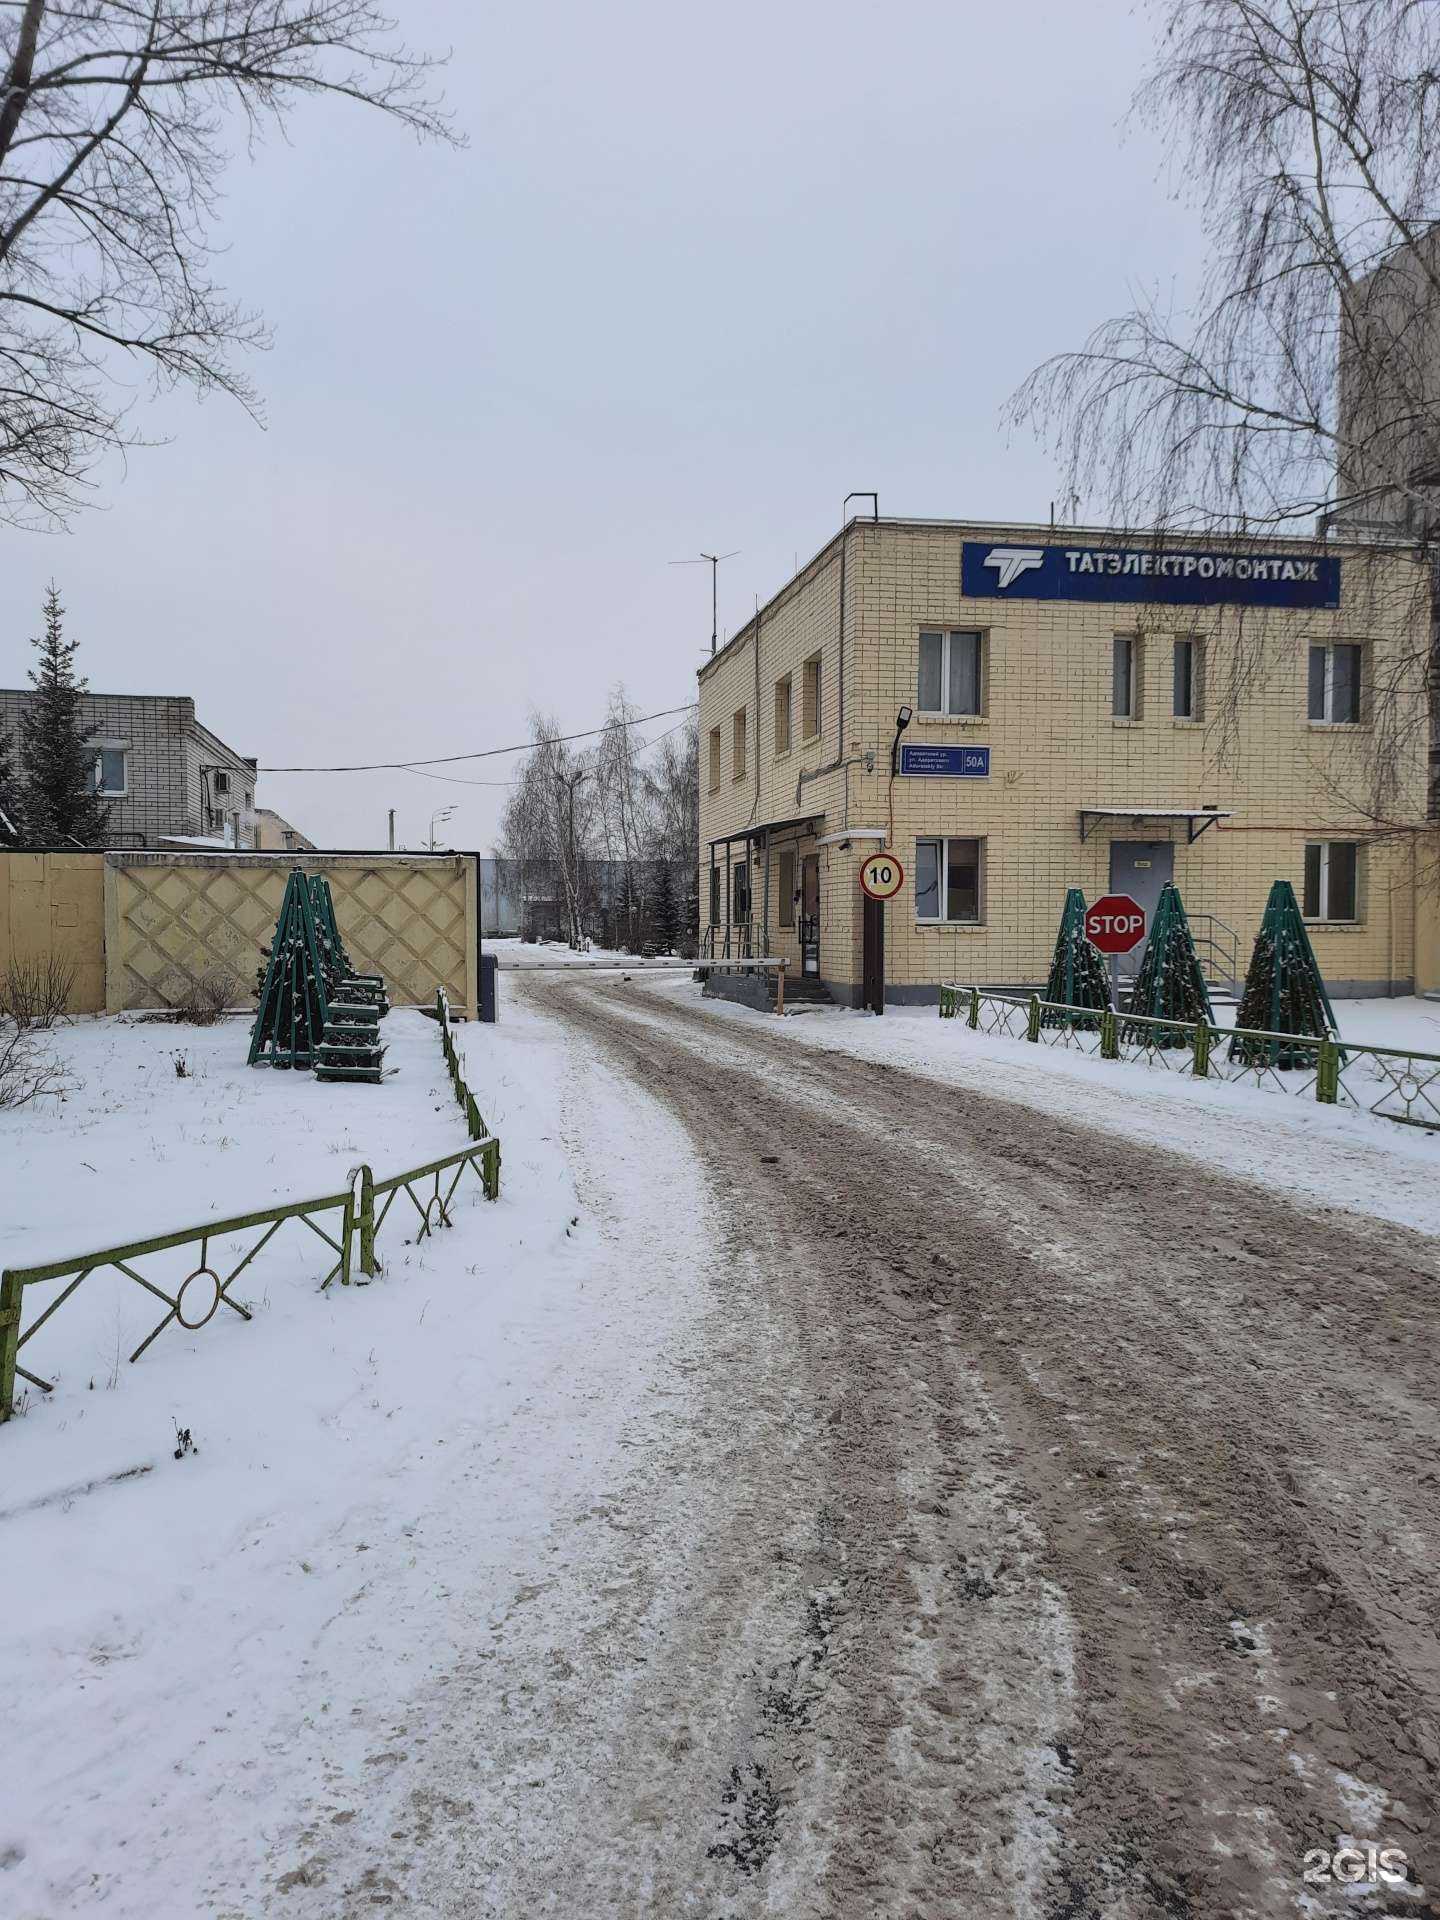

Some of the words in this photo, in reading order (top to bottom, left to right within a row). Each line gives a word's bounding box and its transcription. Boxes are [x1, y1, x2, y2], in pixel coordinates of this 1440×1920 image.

[1065, 551, 1319, 582] ТАТЭЛЕКТРОМОНТАЖ
[966, 756, 985, 768] 50А
[870, 866, 892, 883] 10
[1088, 915, 1143, 934] STOP
